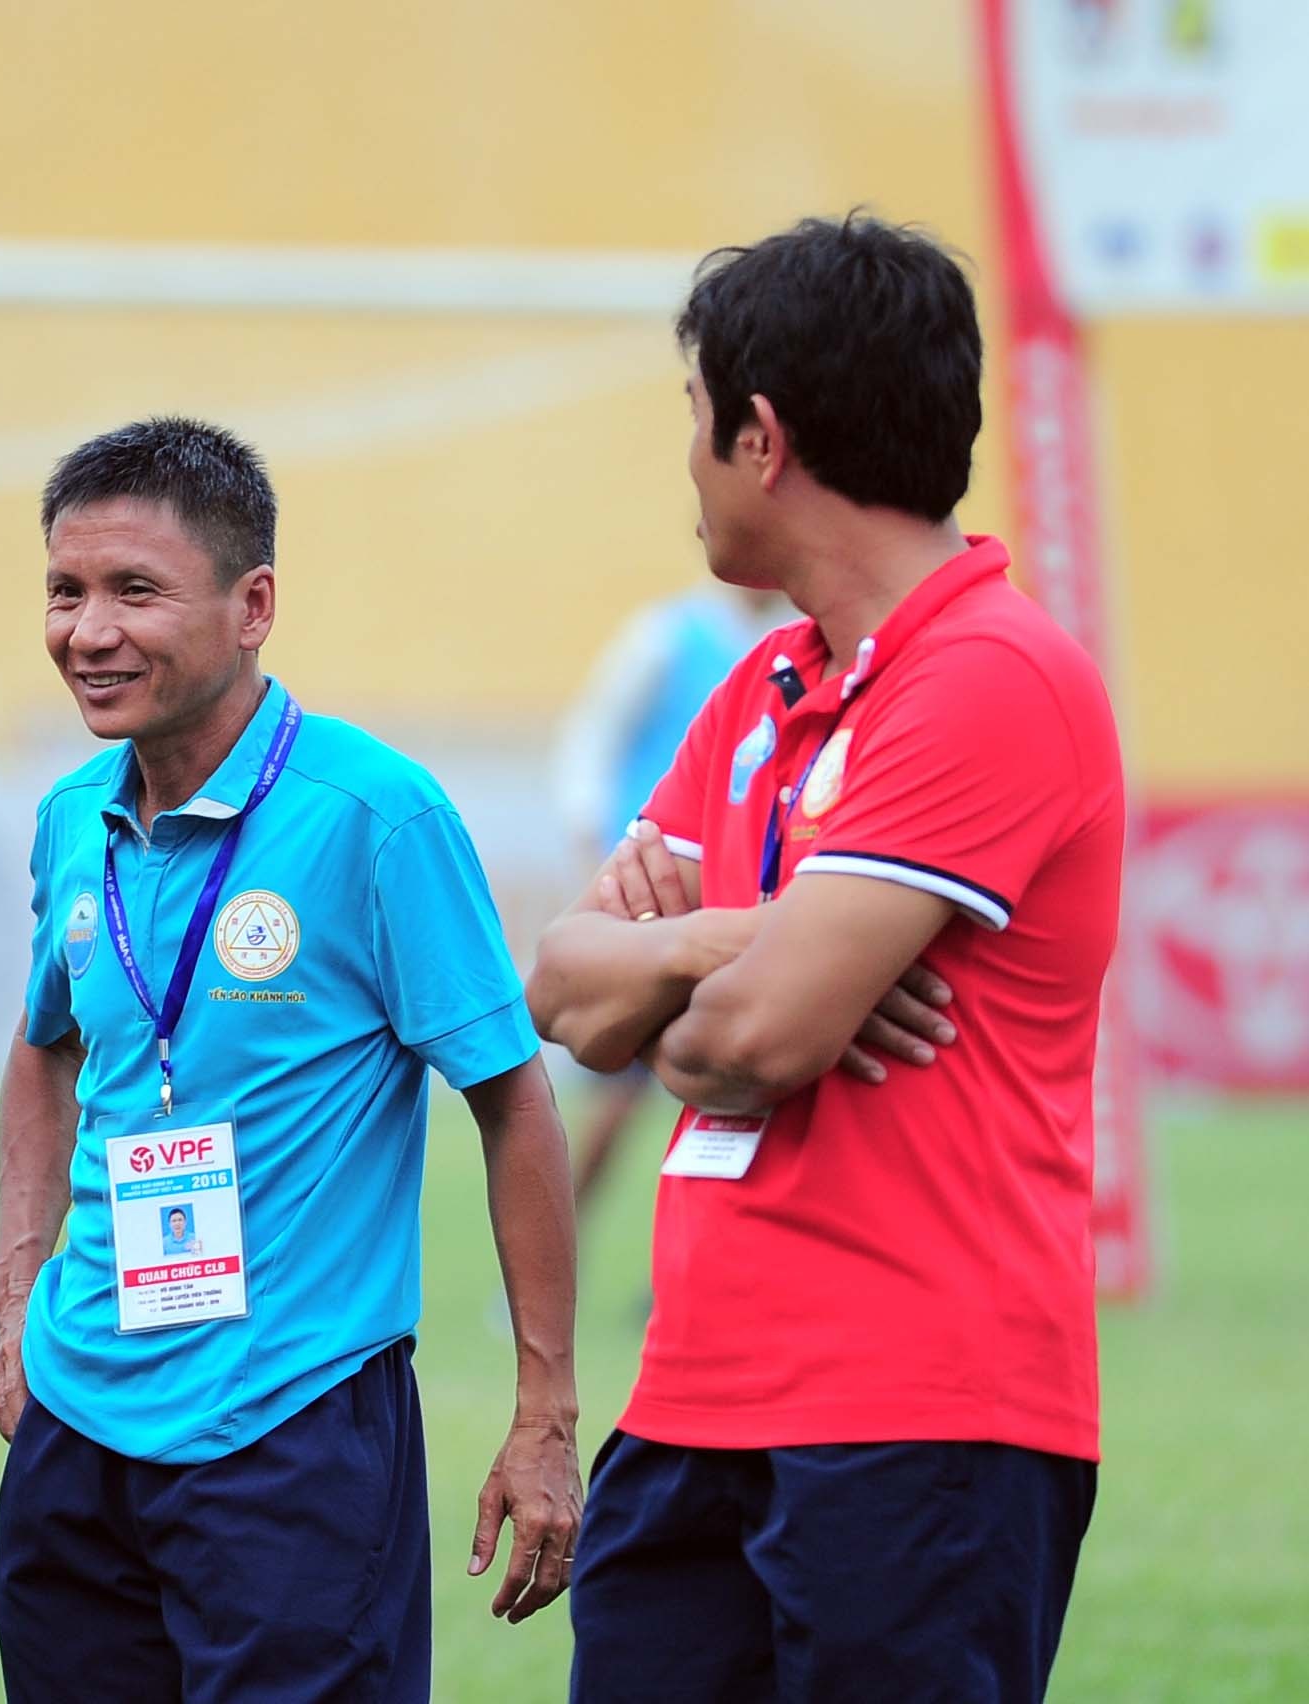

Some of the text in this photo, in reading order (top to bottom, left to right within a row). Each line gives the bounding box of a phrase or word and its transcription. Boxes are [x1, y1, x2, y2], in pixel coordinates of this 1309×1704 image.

[261, 762, 276, 785] VPF
[249, 989, 283, 1002] KHÁNH
[157, 1137, 214, 1165] VPF
[191, 1172, 228, 1189] 2016
[137, 1270, 168, 1284] QUAN
[204, 1261, 227, 1274] CLB
